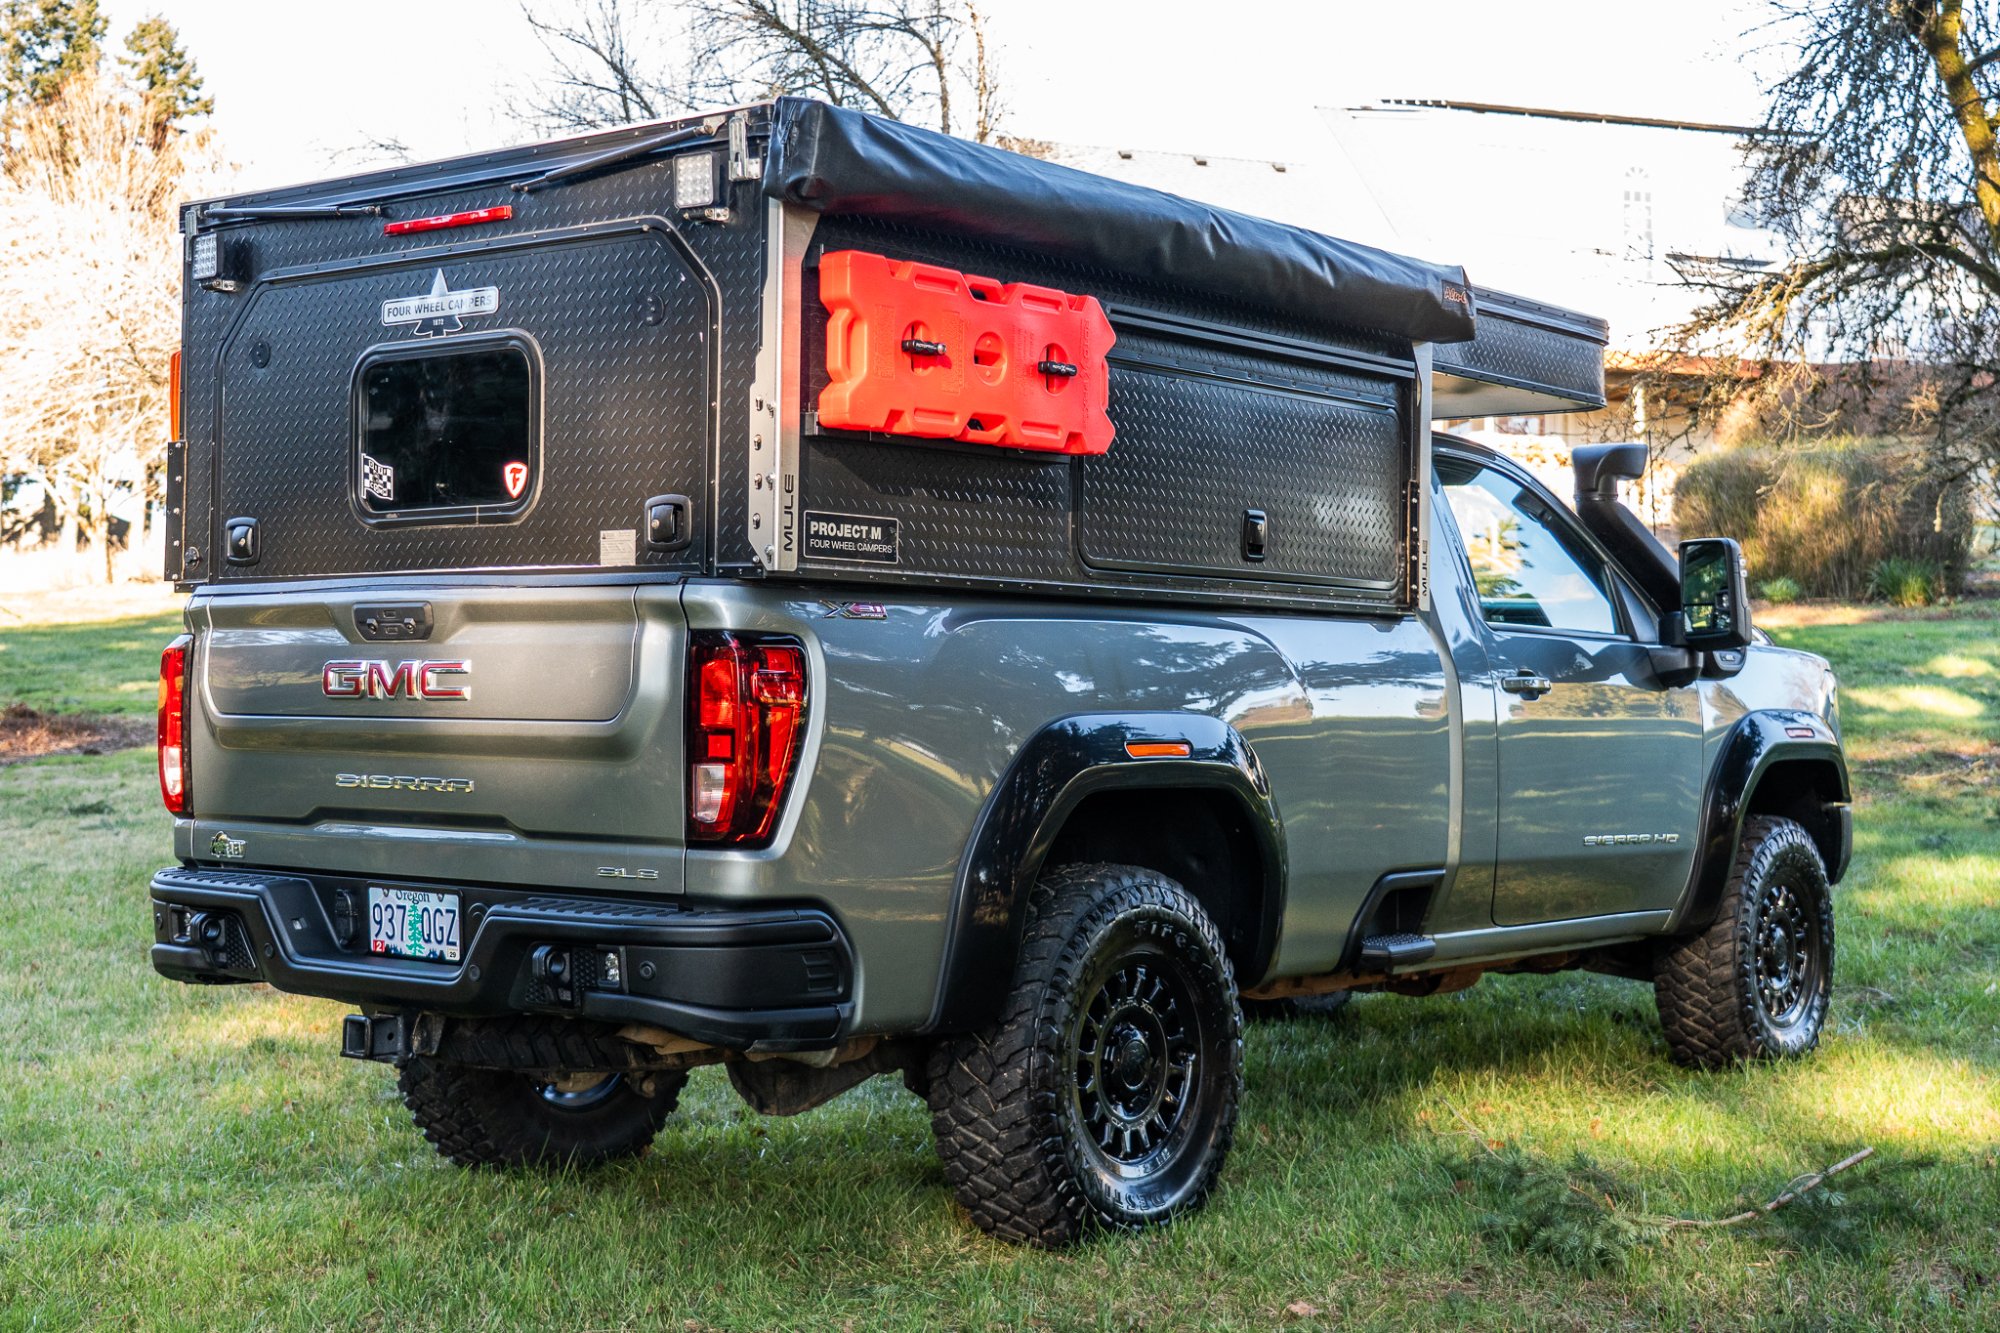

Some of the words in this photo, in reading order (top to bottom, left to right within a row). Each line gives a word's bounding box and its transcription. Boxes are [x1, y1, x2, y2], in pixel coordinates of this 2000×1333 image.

[387, 307, 411, 317] FOUR
[414, 302, 445, 314] WHEEL
[783, 474, 794, 551] MULE
[810, 521, 868, 539] PROJECT
[870, 526, 882, 540] M
[810, 539, 830, 549] FOUR
[831, 540, 856, 551] WHEEL
[857, 543, 893, 554] CAMPERS
[322, 659, 472, 700] GMC
[335, 773, 475, 793] SIERRA
[1584, 834, 1651, 846] SIERRA
[1654, 833, 1679, 843] HD
[395, 890, 431, 905] Oregon
[372, 902, 407, 942] 937
[421, 906, 457, 947] QGZ
